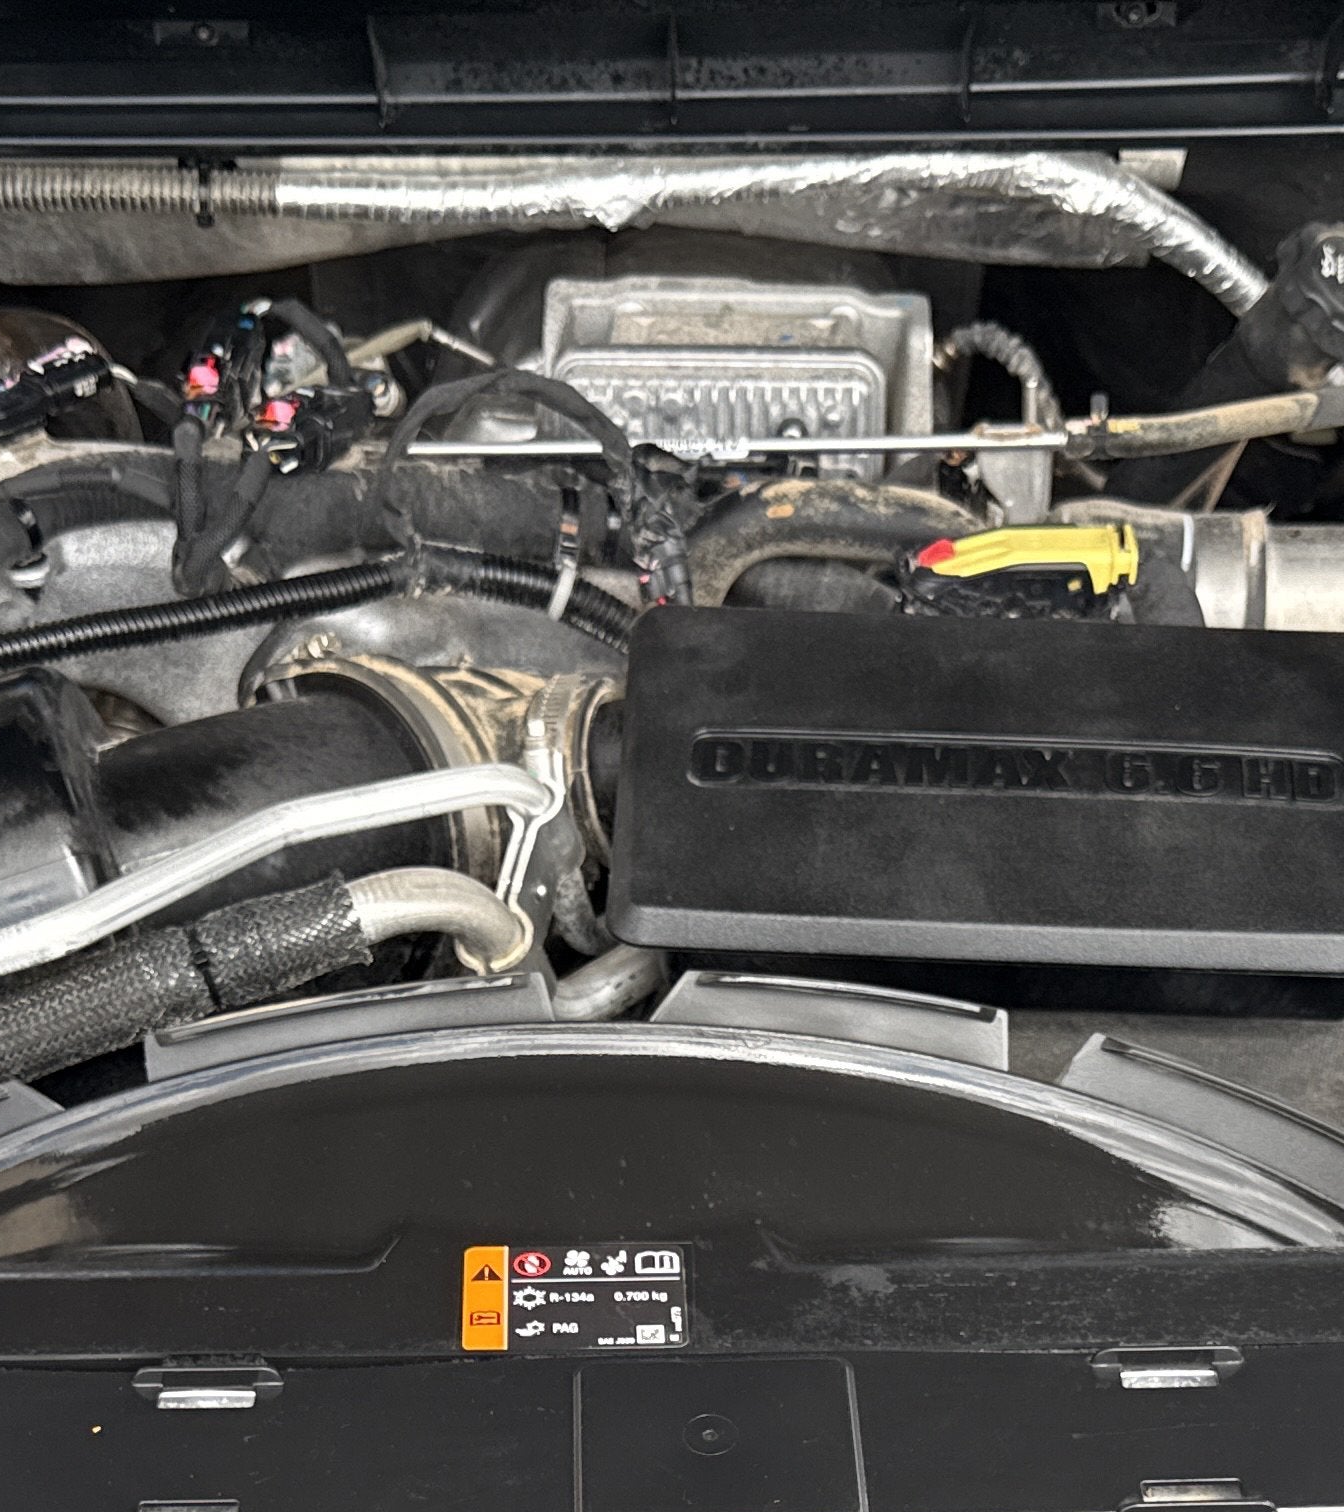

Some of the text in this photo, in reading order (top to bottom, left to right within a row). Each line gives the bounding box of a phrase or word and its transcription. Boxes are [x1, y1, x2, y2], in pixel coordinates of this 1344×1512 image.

[702, 738, 1338, 803] DURAMAX 6.6 HD
[563, 1266, 593, 1276] AUTO
[549, 1291, 595, 1303] R-134a
[651, 1291, 668, 1303] kg
[552, 1322, 579, 1334] PAG
